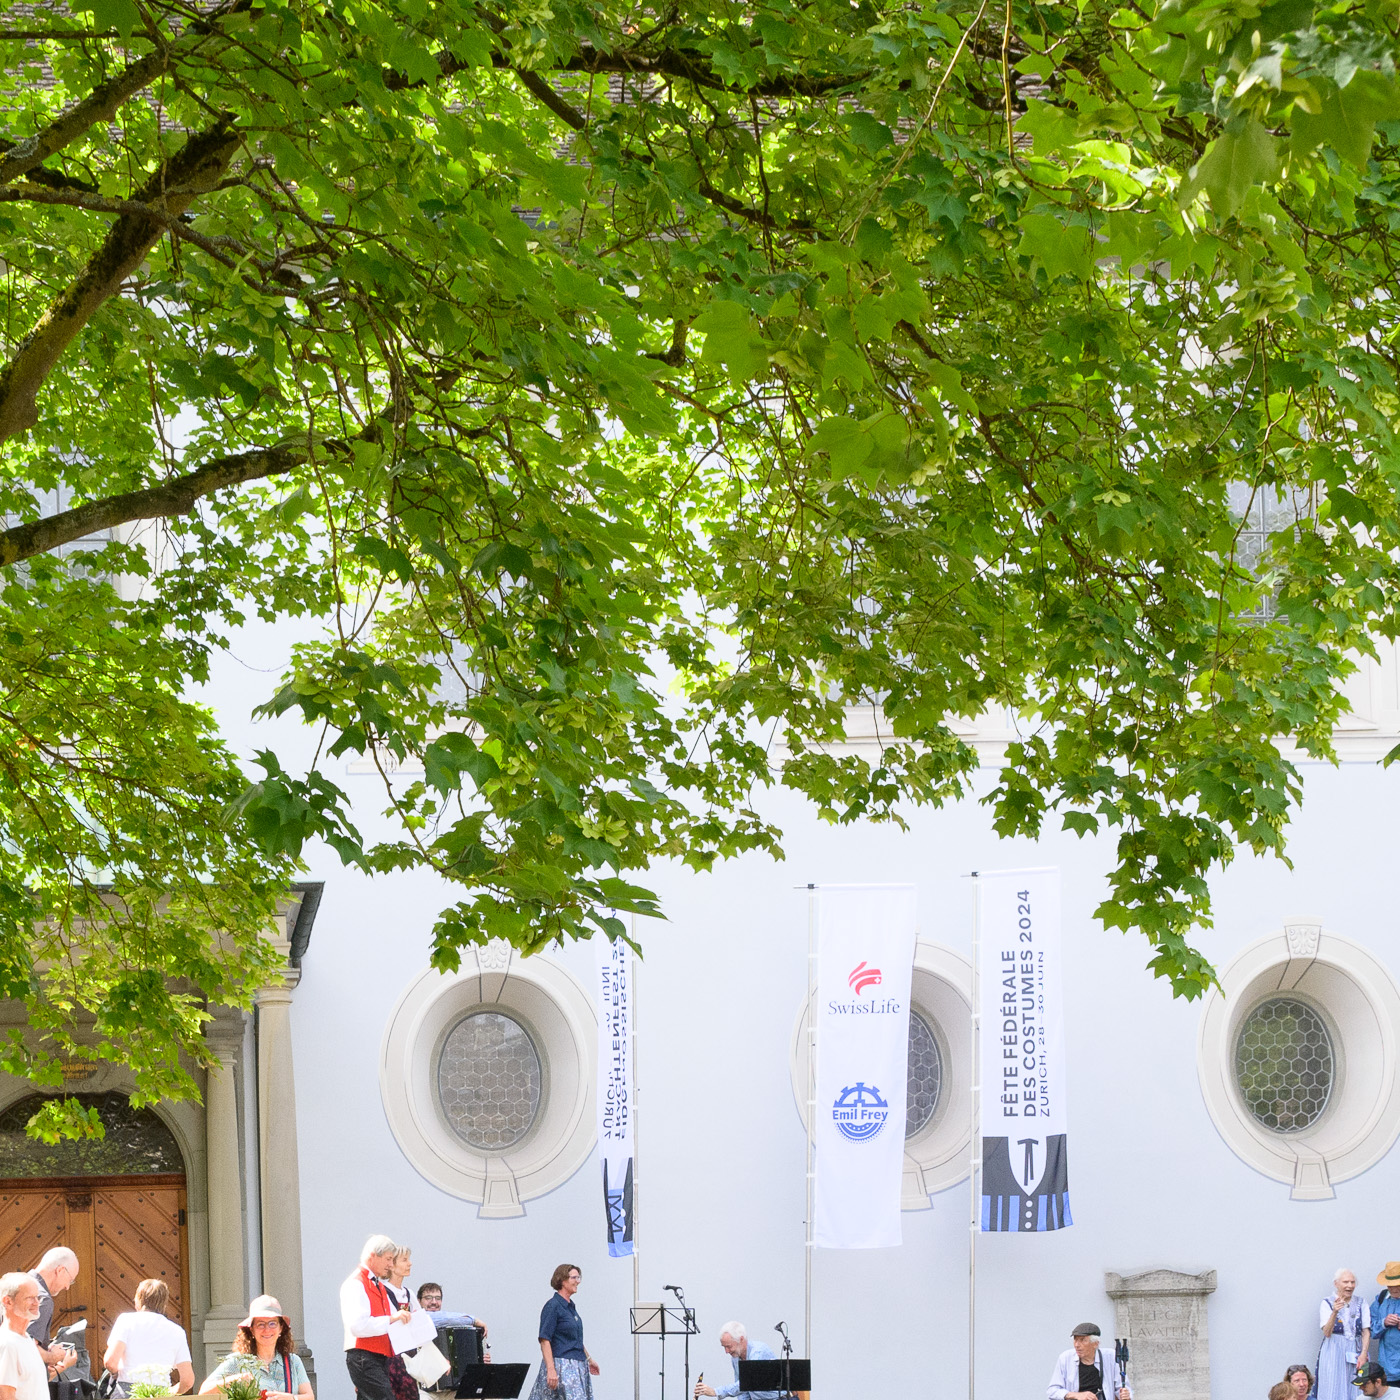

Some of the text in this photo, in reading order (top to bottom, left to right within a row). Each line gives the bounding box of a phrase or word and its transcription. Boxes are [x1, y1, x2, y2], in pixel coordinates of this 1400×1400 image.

[1016, 889, 1037, 1117] DES COSTUMES 2024
[1037, 951, 1045, 990] JUIN
[999, 950, 1019, 1118] FÊTE FÉDÉRALE
[832, 1108, 889, 1122] Emil Frey
[1038, 1050, 1051, 1118] ZURICH,
